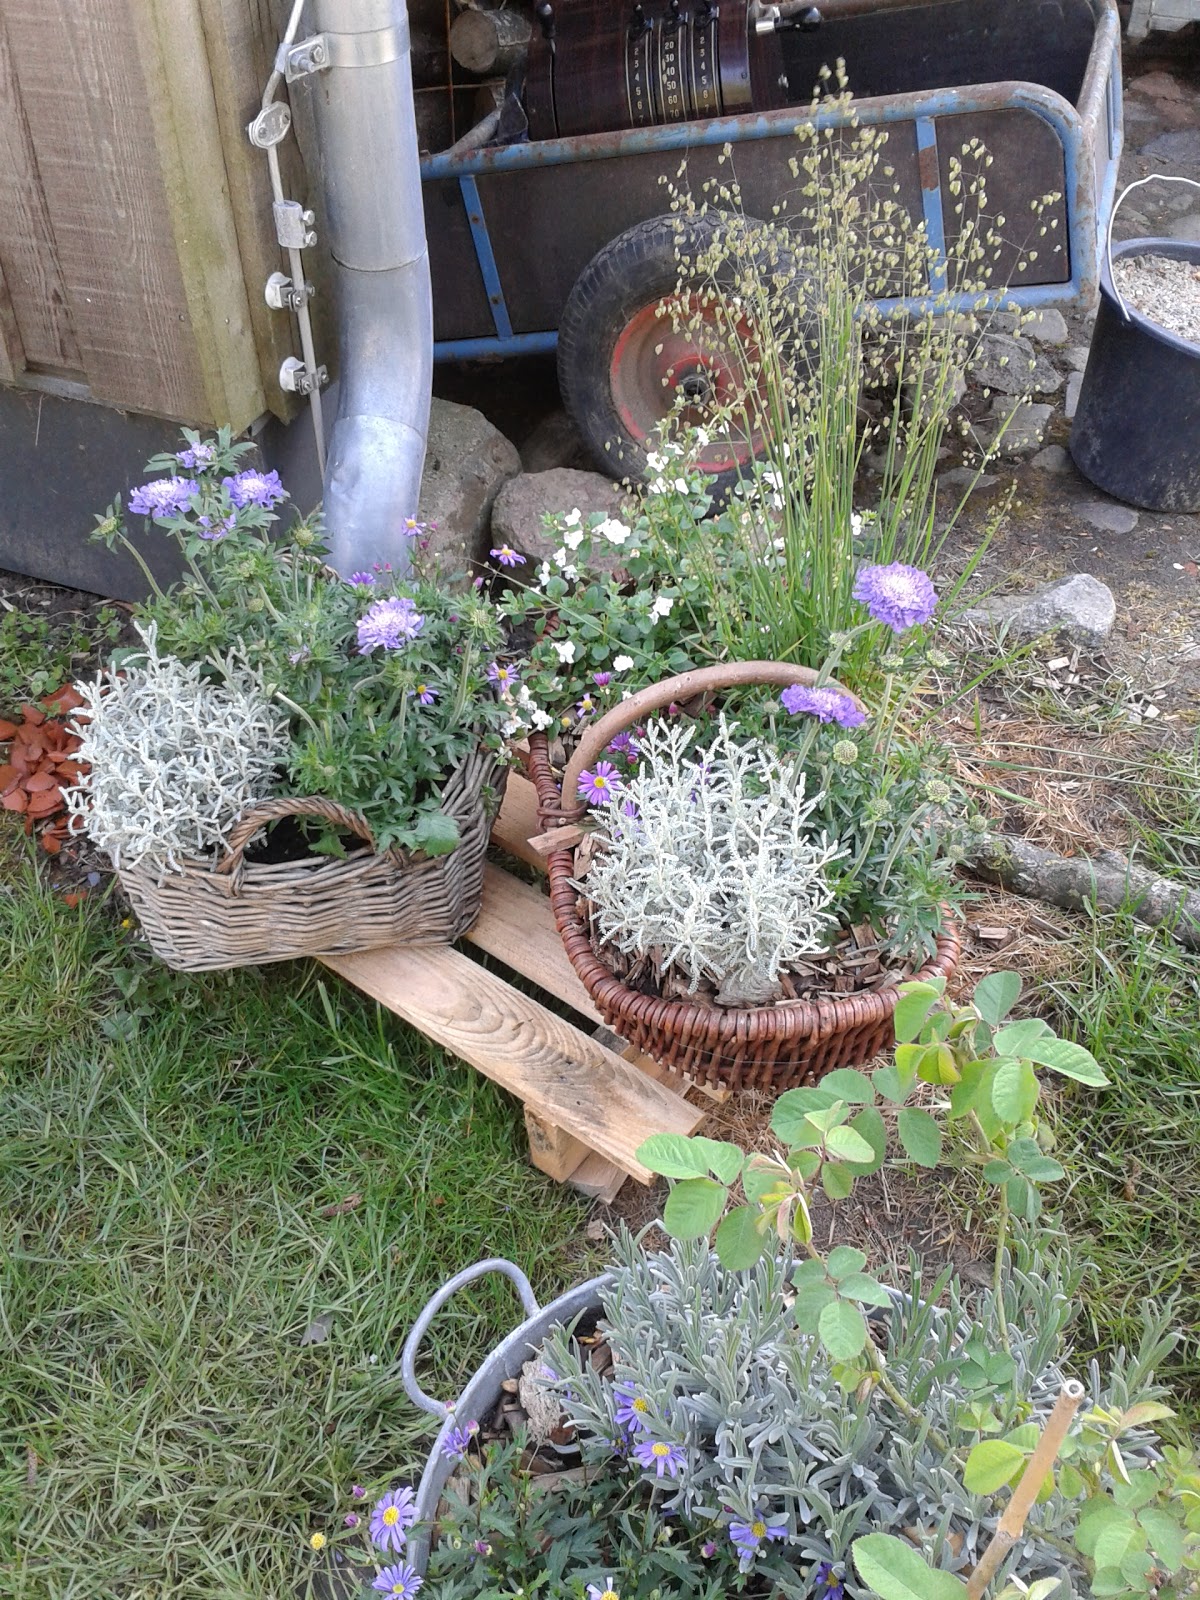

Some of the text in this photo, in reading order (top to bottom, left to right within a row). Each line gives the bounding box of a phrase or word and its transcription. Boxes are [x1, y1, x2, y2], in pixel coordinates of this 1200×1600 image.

[664, 41, 674, 50] 20
[665, 54, 674, 62] 30
[700, 62, 706, 70] 4
[666, 67, 675, 76] 40
[634, 73, 640, 82] 4
[702, 76, 707, 85] 5
[667, 81, 676, 90] 50
[635, 86, 641, 96] 5
[668, 95, 678, 104] 60
[637, 101, 642, 110] 6
[670, 109, 679, 118] 70
